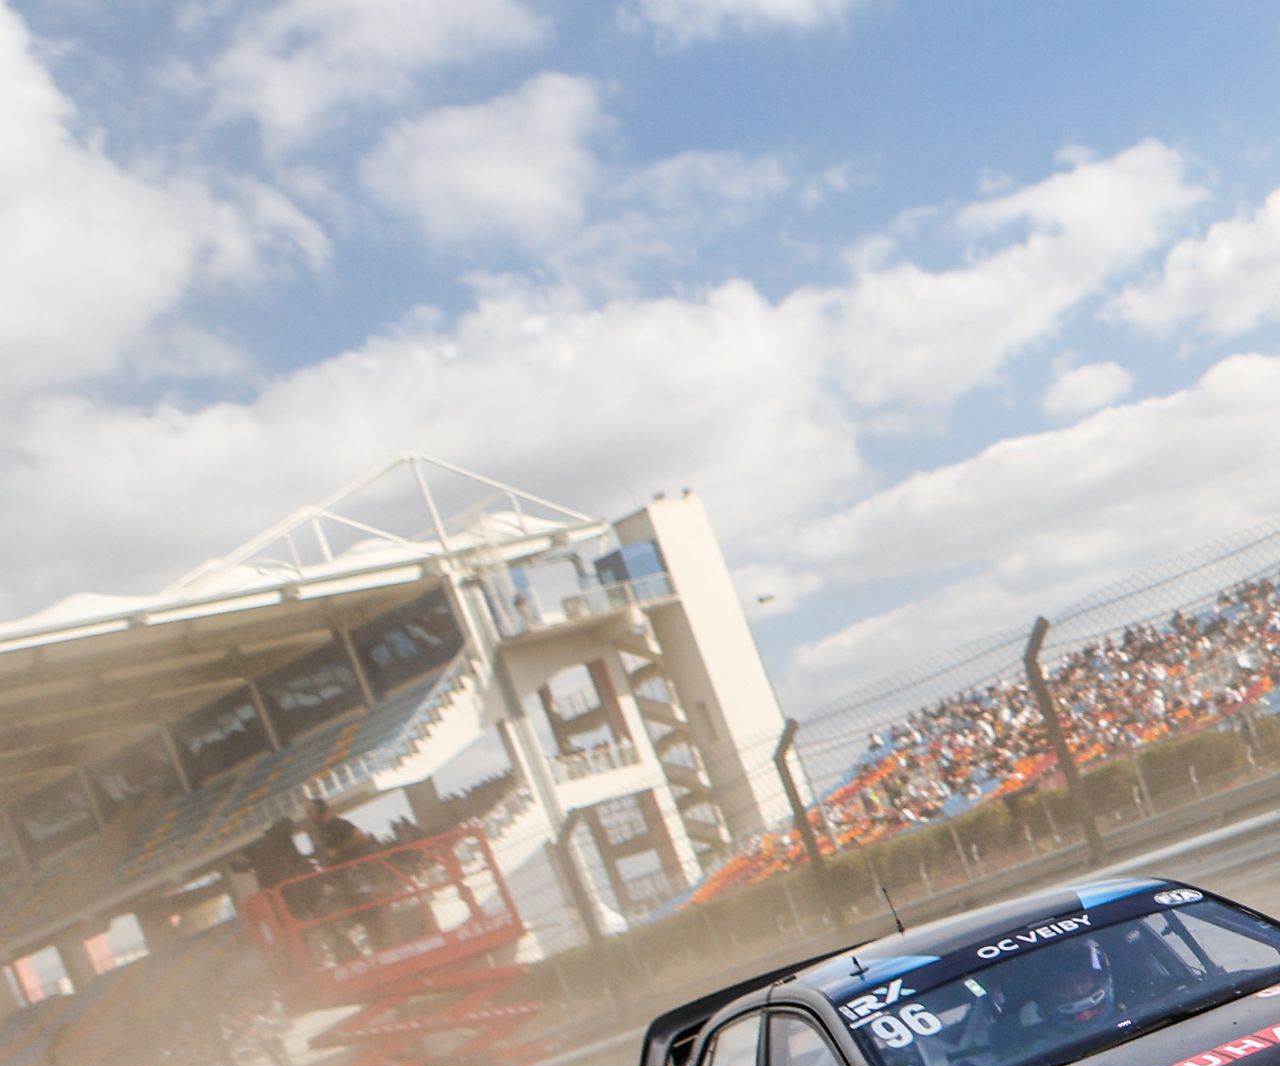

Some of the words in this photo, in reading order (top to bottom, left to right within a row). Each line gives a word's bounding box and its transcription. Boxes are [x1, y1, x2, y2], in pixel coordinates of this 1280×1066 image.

[977, 938, 1020, 959] OC
[1016, 914, 1091, 944] VEIBY
[846, 978, 917, 1017] RX
[871, 1003, 942, 1049] 96
